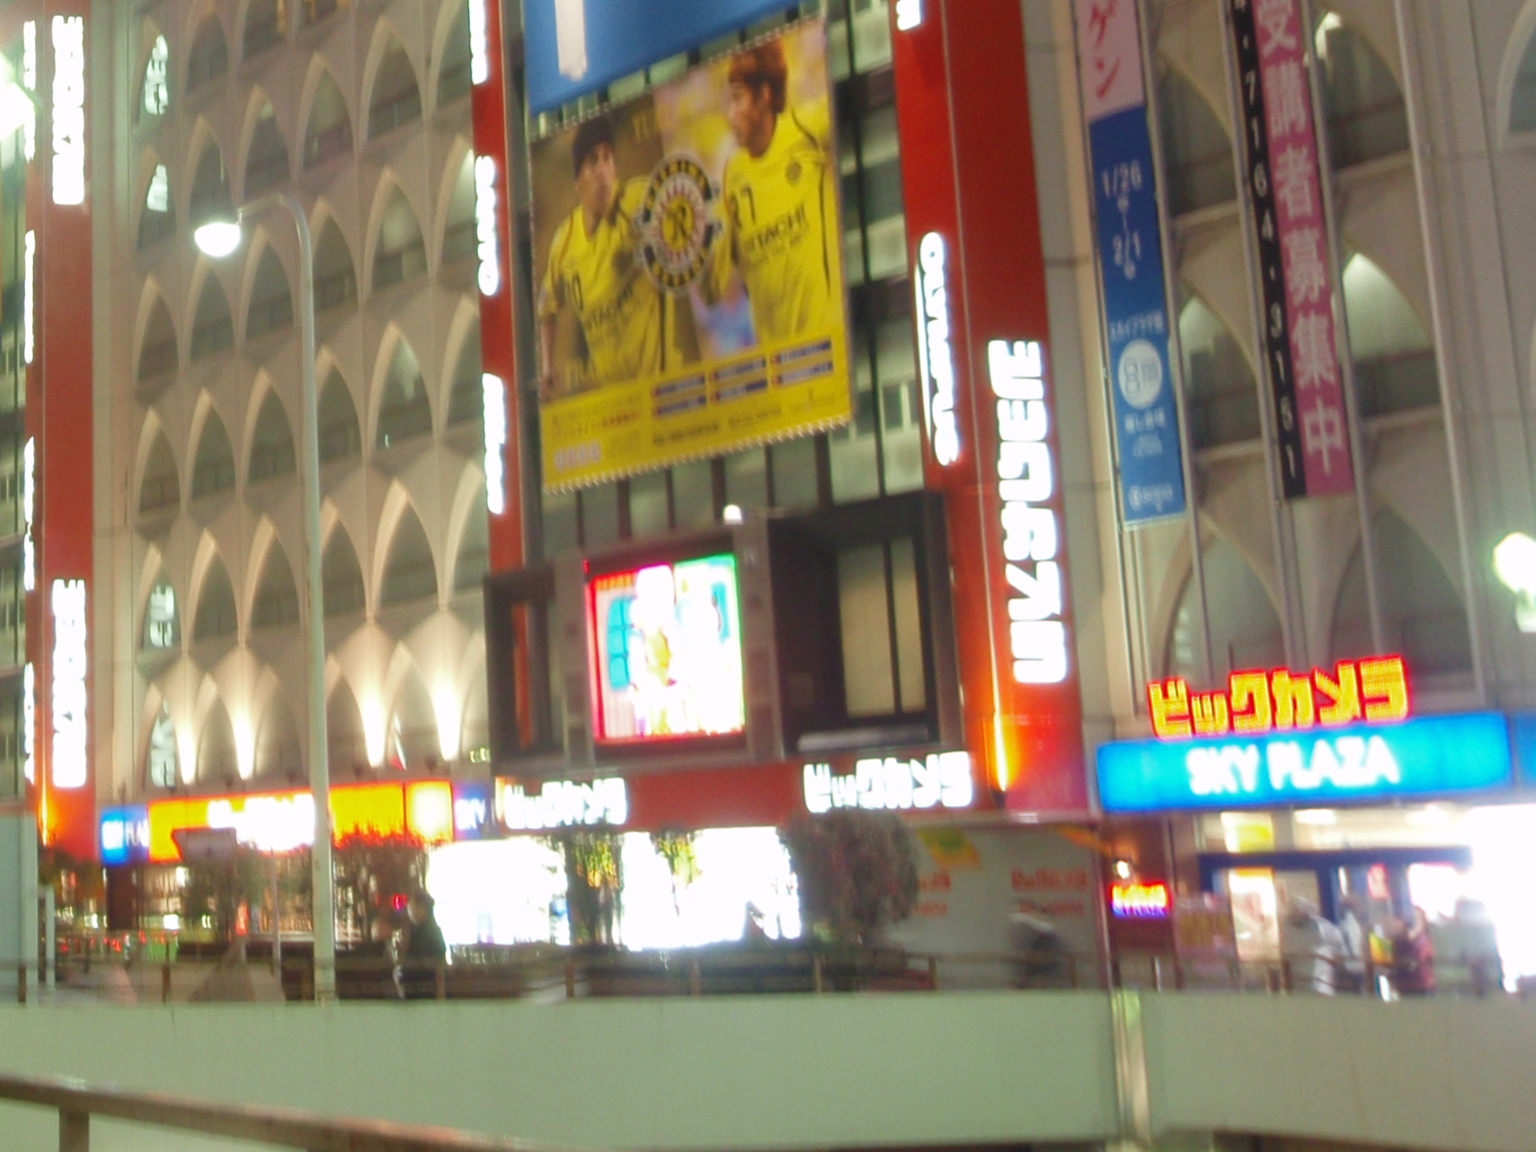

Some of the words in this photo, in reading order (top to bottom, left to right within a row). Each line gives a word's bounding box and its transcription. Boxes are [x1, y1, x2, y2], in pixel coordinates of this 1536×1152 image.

[916, 232, 962, 466] OLYMPUS
[1147, 653, 1409, 740] ビックカメラ
[802, 749, 974, 815] ビックカメラ
[1185, 744, 1261, 797] SKY
[1266, 734, 1401, 791] PLAZA
[503, 776, 628, 830] ビックカメラ
